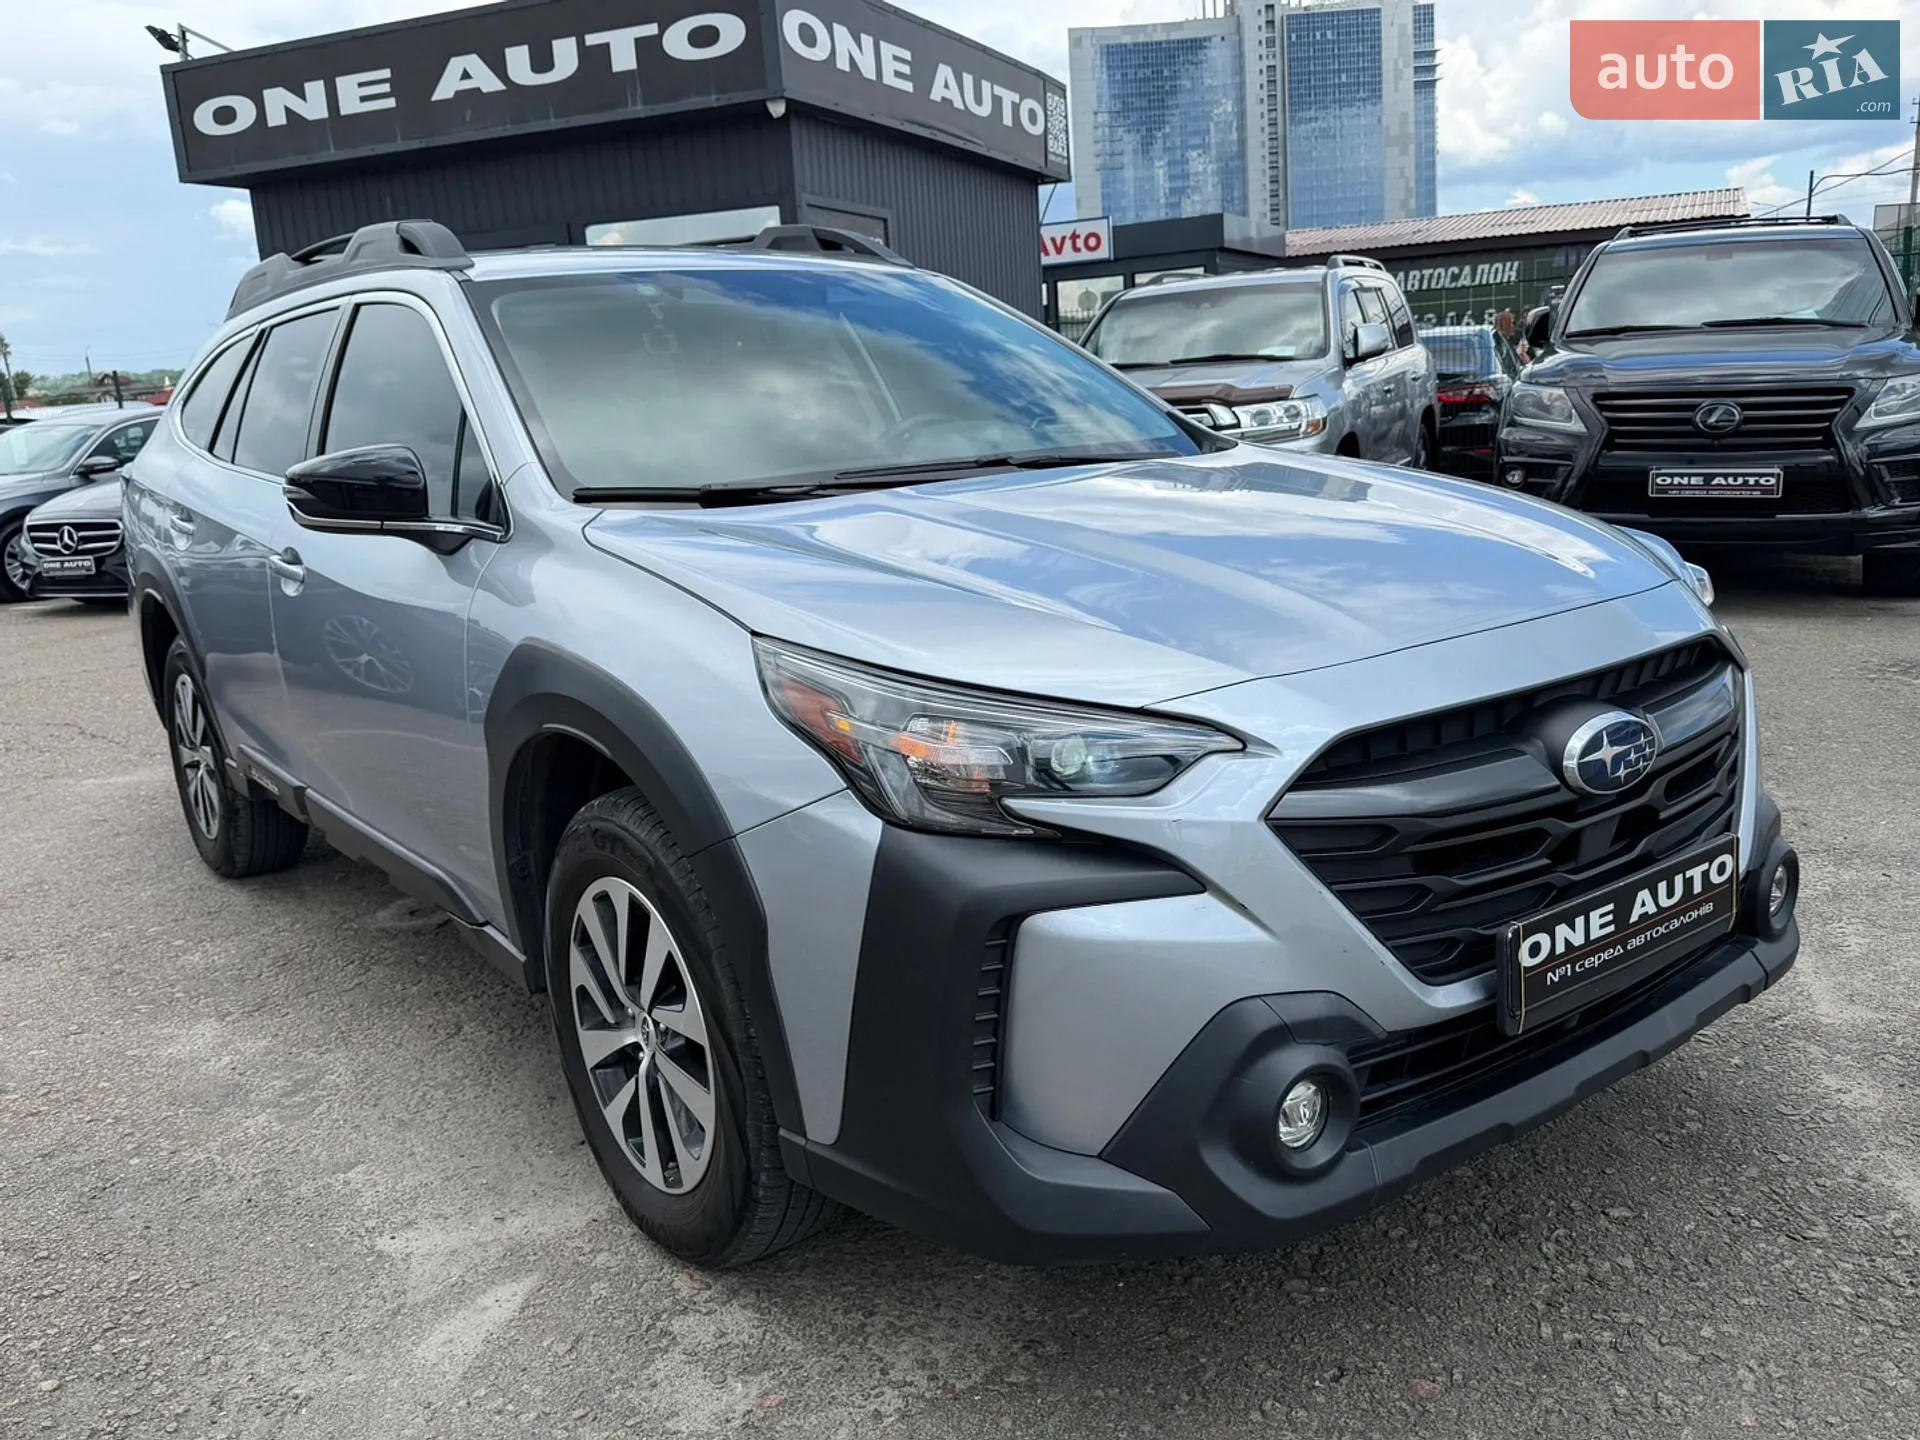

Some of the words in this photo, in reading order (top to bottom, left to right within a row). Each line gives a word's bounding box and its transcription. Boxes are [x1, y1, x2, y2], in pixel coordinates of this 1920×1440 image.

[193, 68, 396, 136] ONE
[431, 12, 747, 102] AUTO
[782, 9, 914, 92] ONE
[930, 63, 1046, 136] AUTO
[1395, 261, 1519, 292] АВТОСАЛОН
[1655, 476, 1704, 485] ONE
[1711, 476, 1776, 485] AUTO
[1518, 903, 1616, 967] ONE
[1629, 854, 1734, 924] AUTO
[1575, 944, 1624, 972] серед
[1626, 902, 1714, 950] автосалонів
